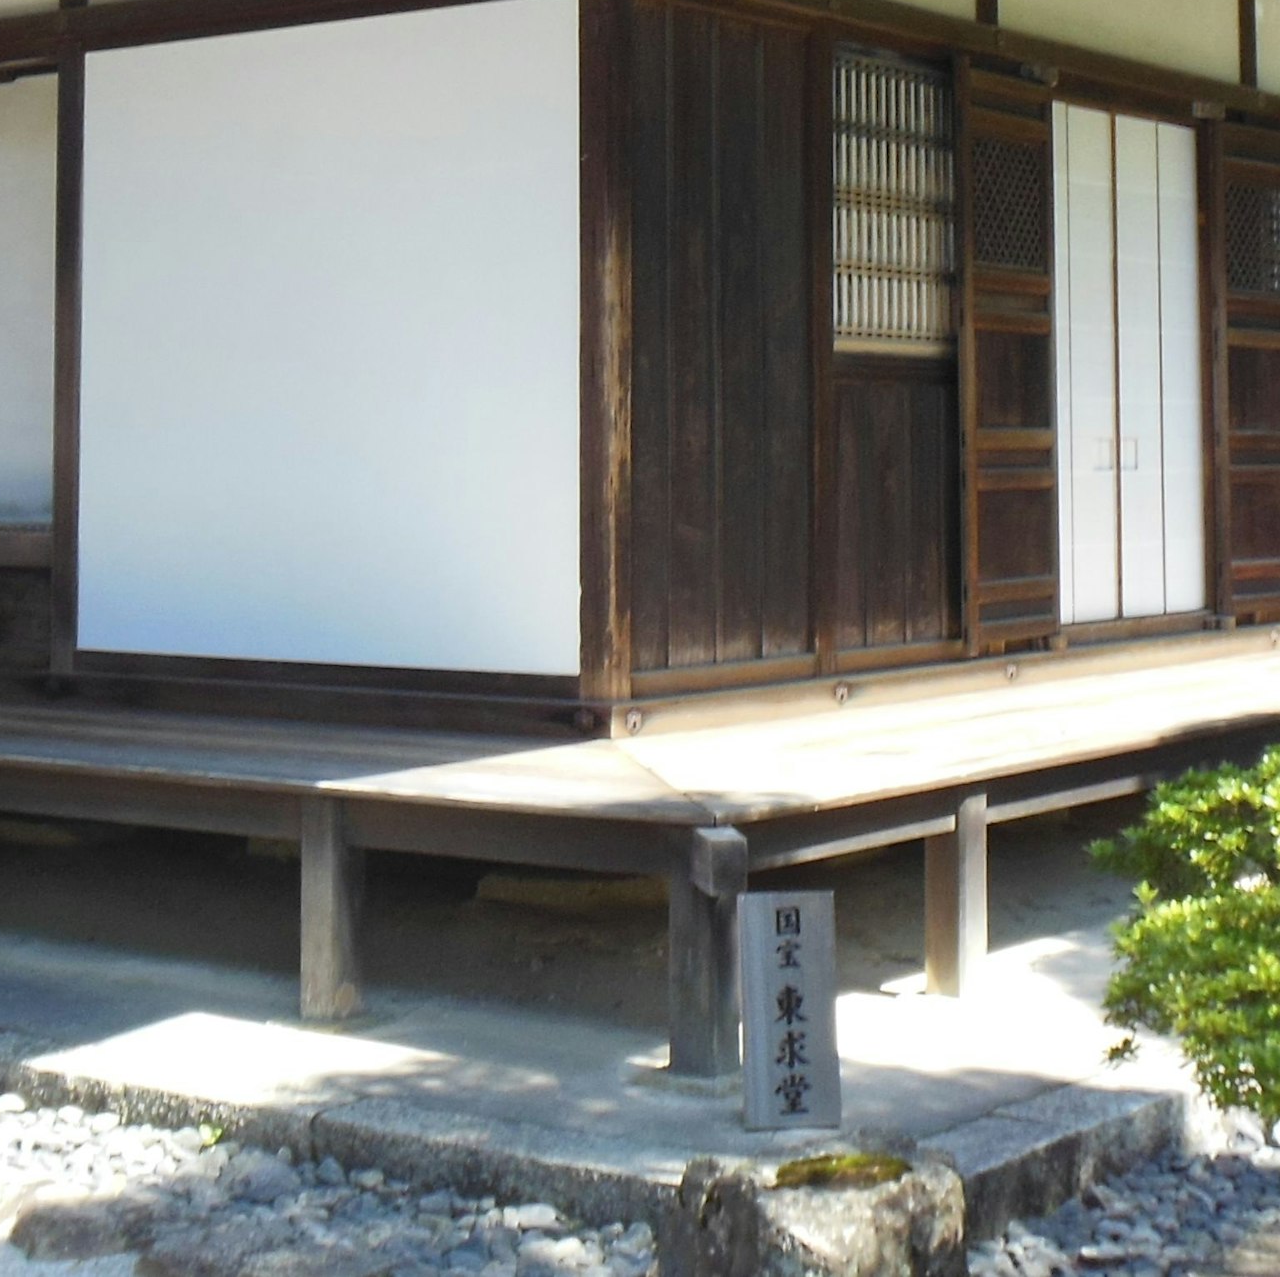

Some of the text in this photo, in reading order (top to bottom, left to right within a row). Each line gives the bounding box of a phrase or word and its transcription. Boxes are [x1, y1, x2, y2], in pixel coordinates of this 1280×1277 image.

[774, 905, 811, 1116] 国宝 東求堂
